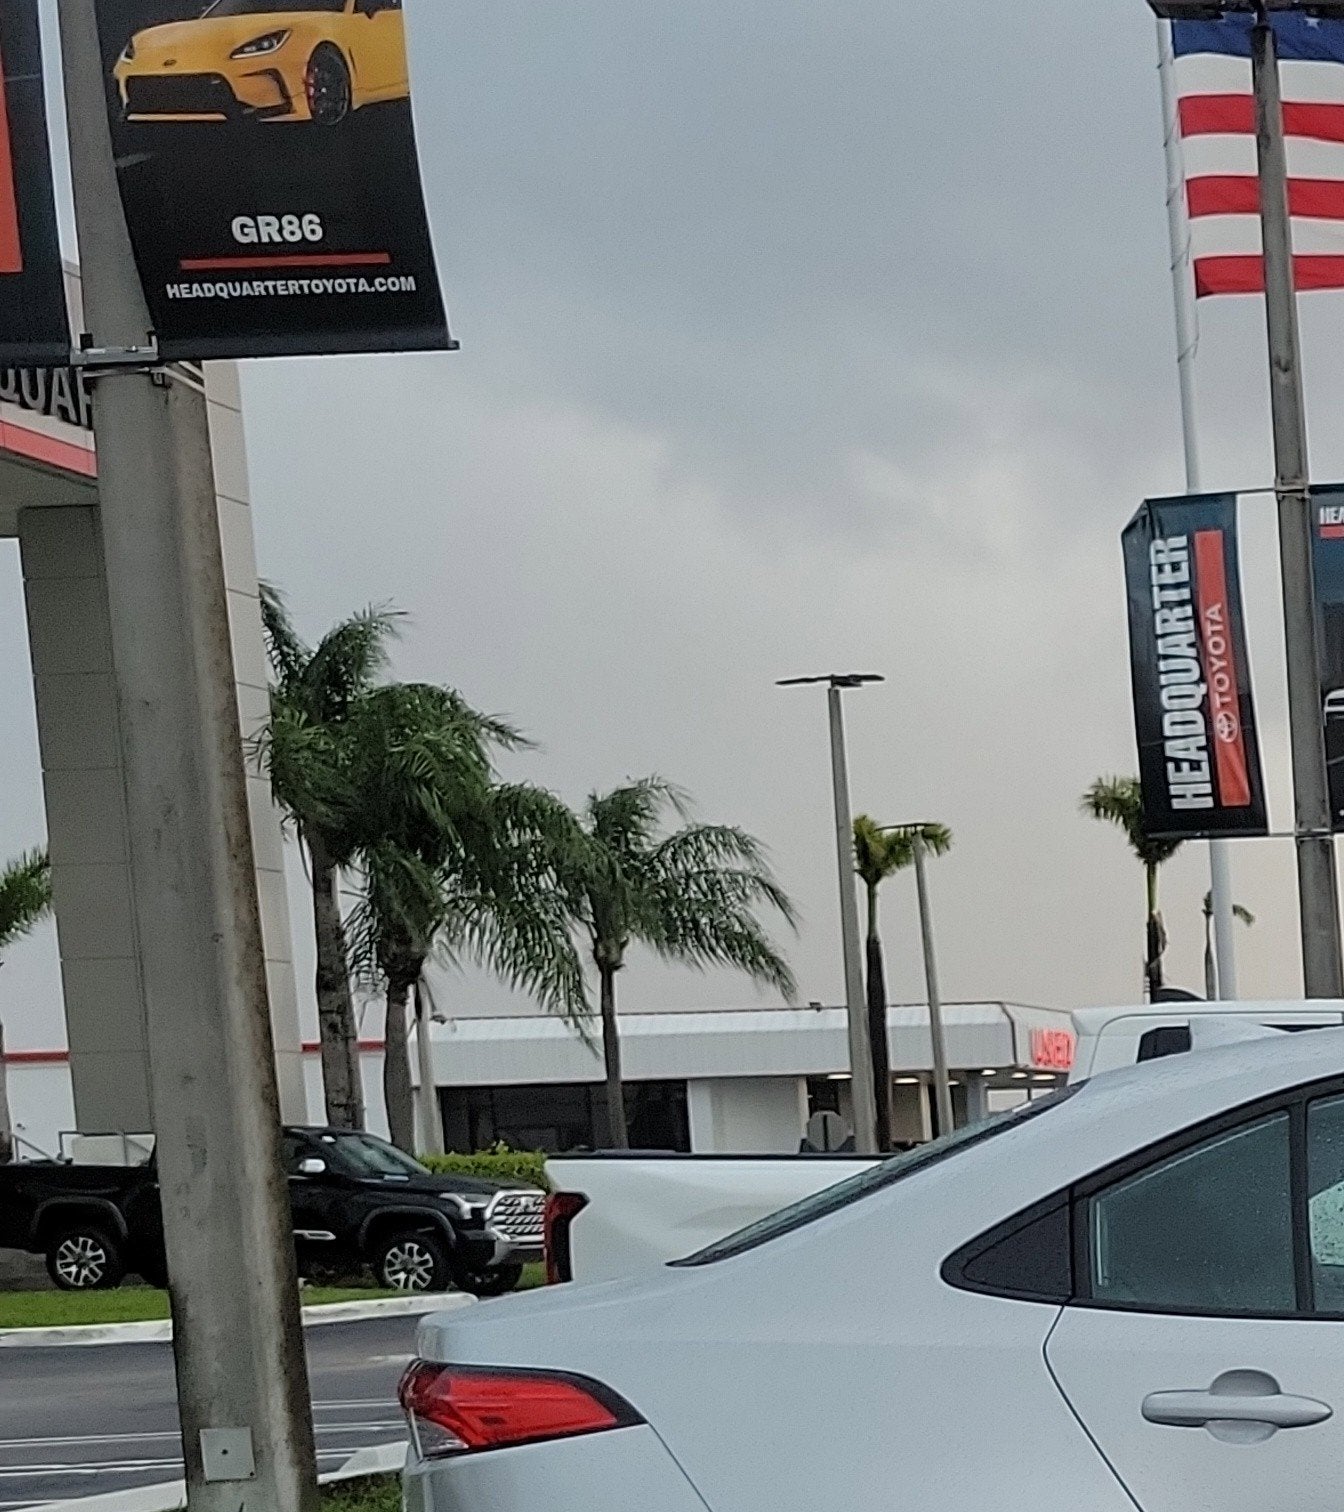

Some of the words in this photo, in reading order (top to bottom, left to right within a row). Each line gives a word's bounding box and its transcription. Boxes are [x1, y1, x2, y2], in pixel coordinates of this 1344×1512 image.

[231, 214, 323, 243] GR86
[166, 276, 416, 299] HEADQUARTERTOYOTA.COM
[1151, 534, 1214, 809] HEADQUARTER
[1206, 604, 1231, 709] TOYOTA
